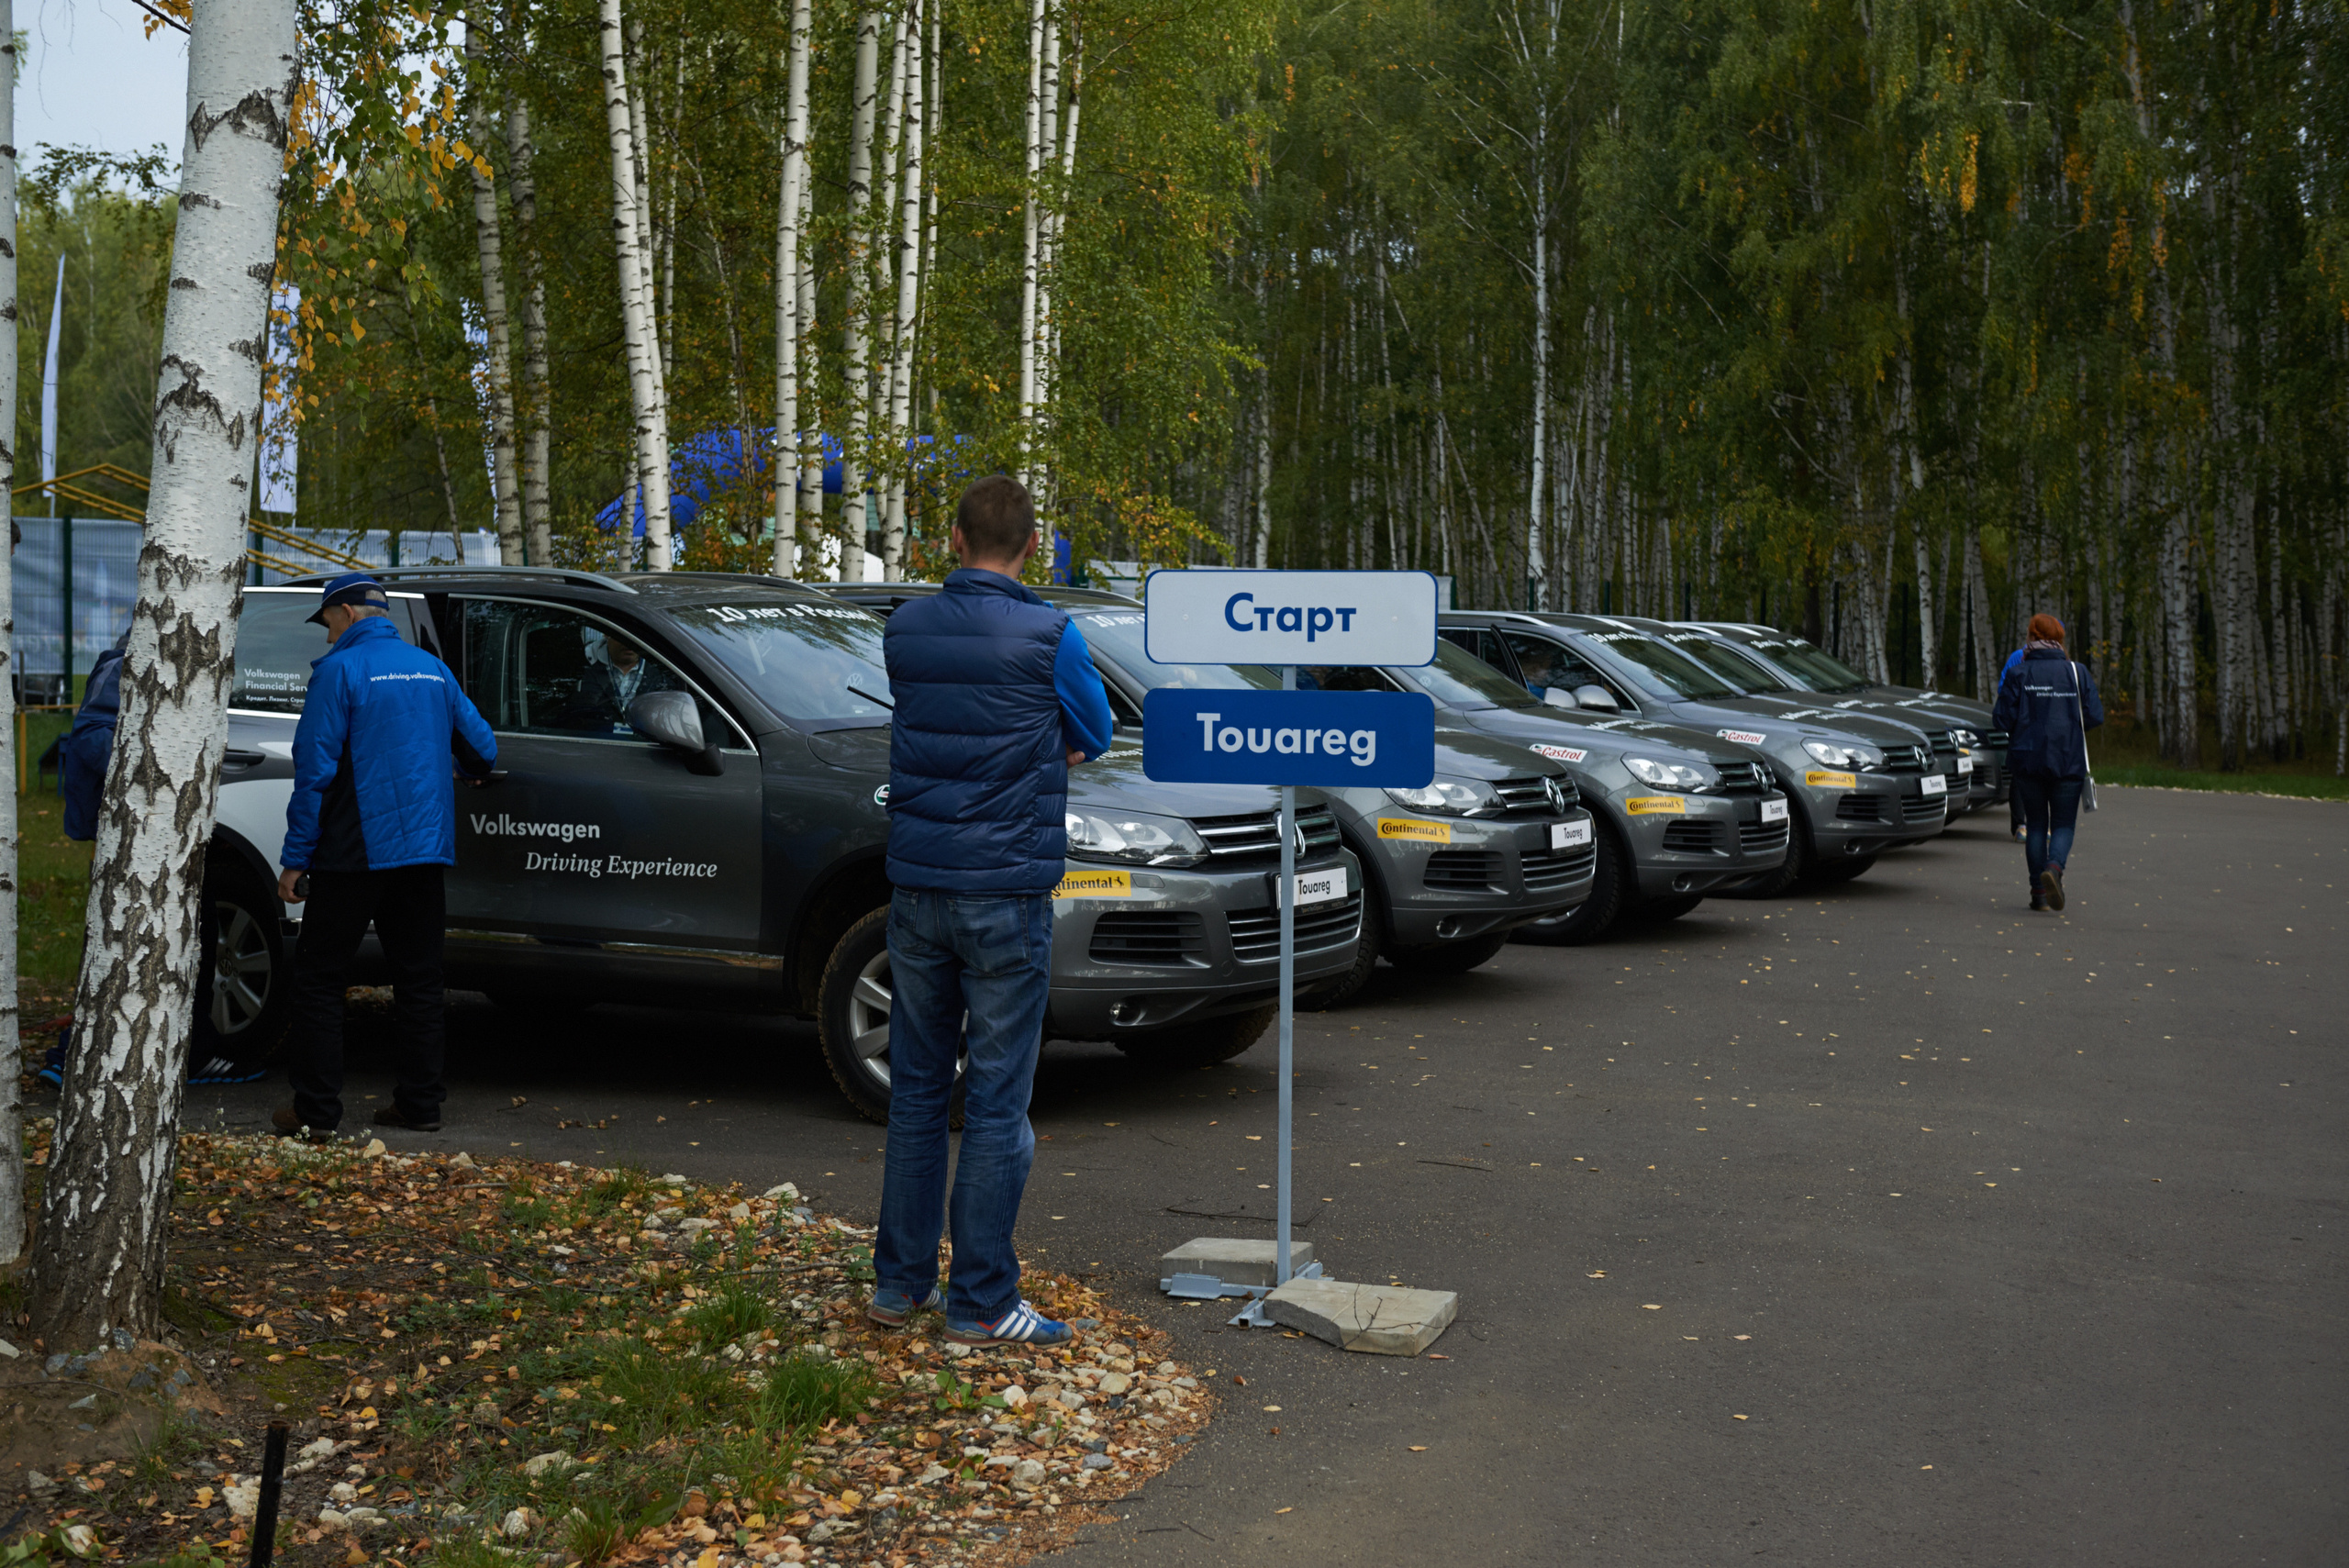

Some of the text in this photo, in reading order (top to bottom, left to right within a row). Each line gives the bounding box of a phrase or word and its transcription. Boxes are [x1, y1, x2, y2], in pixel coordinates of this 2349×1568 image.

[707, 606, 747, 623] 10
[747, 607, 787, 618] лет
[785, 607, 805, 617] в
[1085, 615, 1116, 628] 10
[1224, 592, 1357, 642] Старт
[244, 668, 300, 681] Volkswagen
[245, 680, 307, 692] Financial Serv
[1197, 713, 1375, 766] Touareg
[1728, 731, 1762, 743] Castrol
[1542, 747, 1583, 761] Castrol
[1630, 801, 1675, 812] Continental
[470, 813, 601, 843] Volkswagen
[1381, 822, 1438, 836] Continental
[1564, 827, 1583, 840] Touareg
[524, 851, 718, 880] Driving Experience
[1052, 876, 1113, 896] ntinental
[1297, 879, 1330, 895] Touareg
